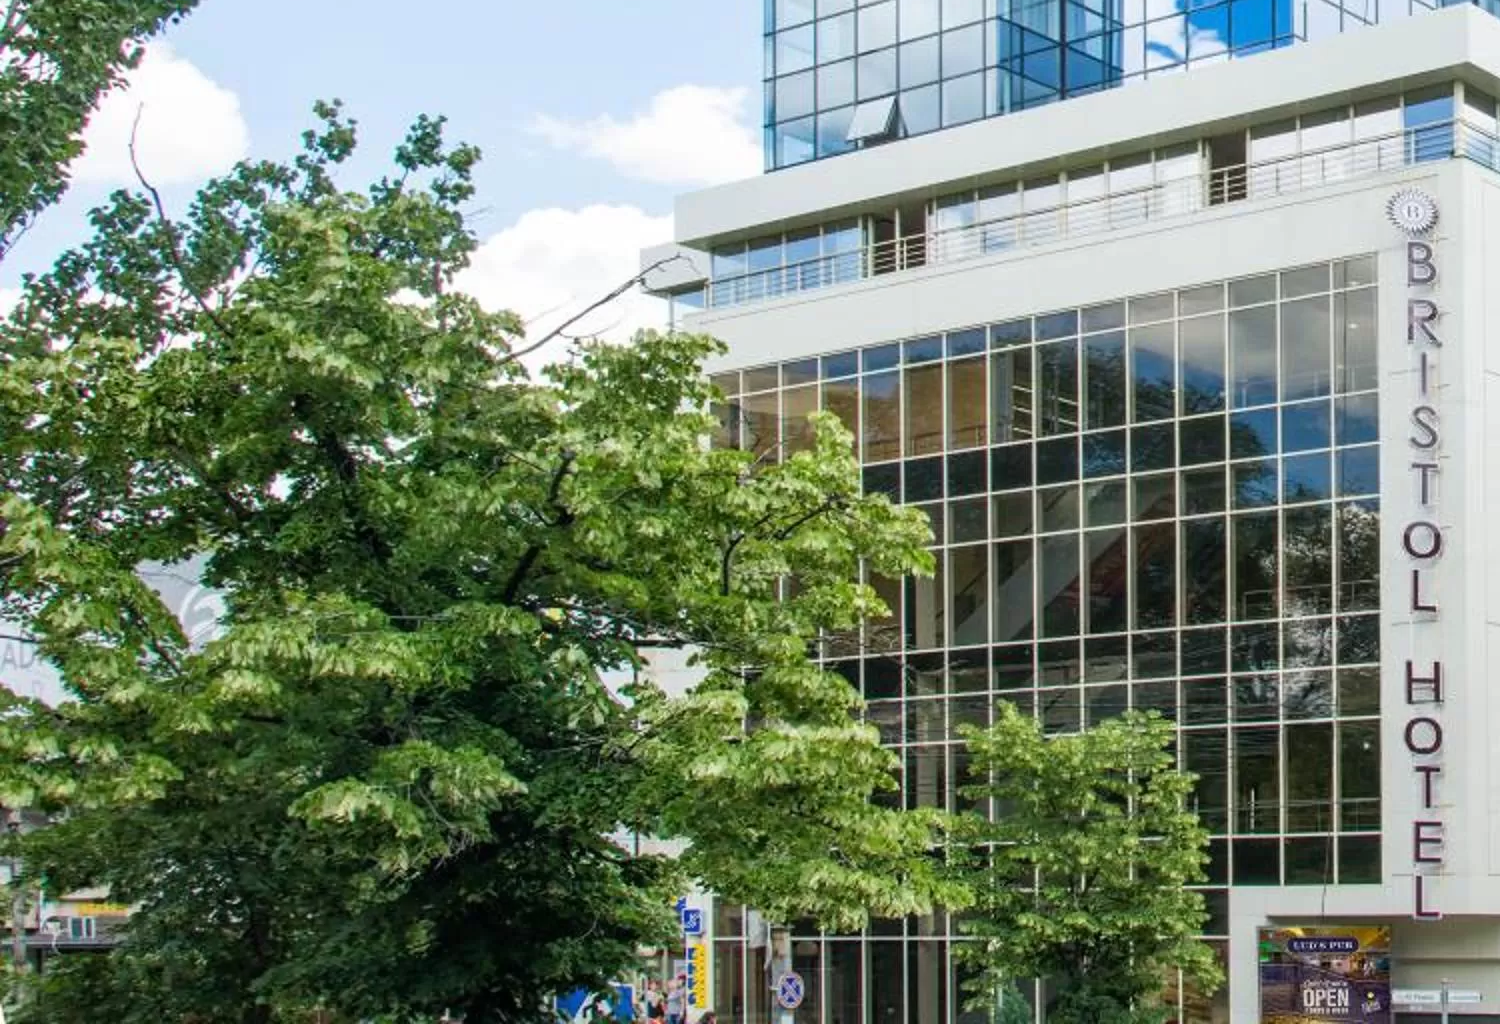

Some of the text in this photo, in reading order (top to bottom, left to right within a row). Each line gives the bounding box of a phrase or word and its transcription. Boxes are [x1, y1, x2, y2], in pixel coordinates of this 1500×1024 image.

[1402, 241, 1444, 918] BRISTOL HOTEL
[1302, 987, 1349, 1007] OPEN
